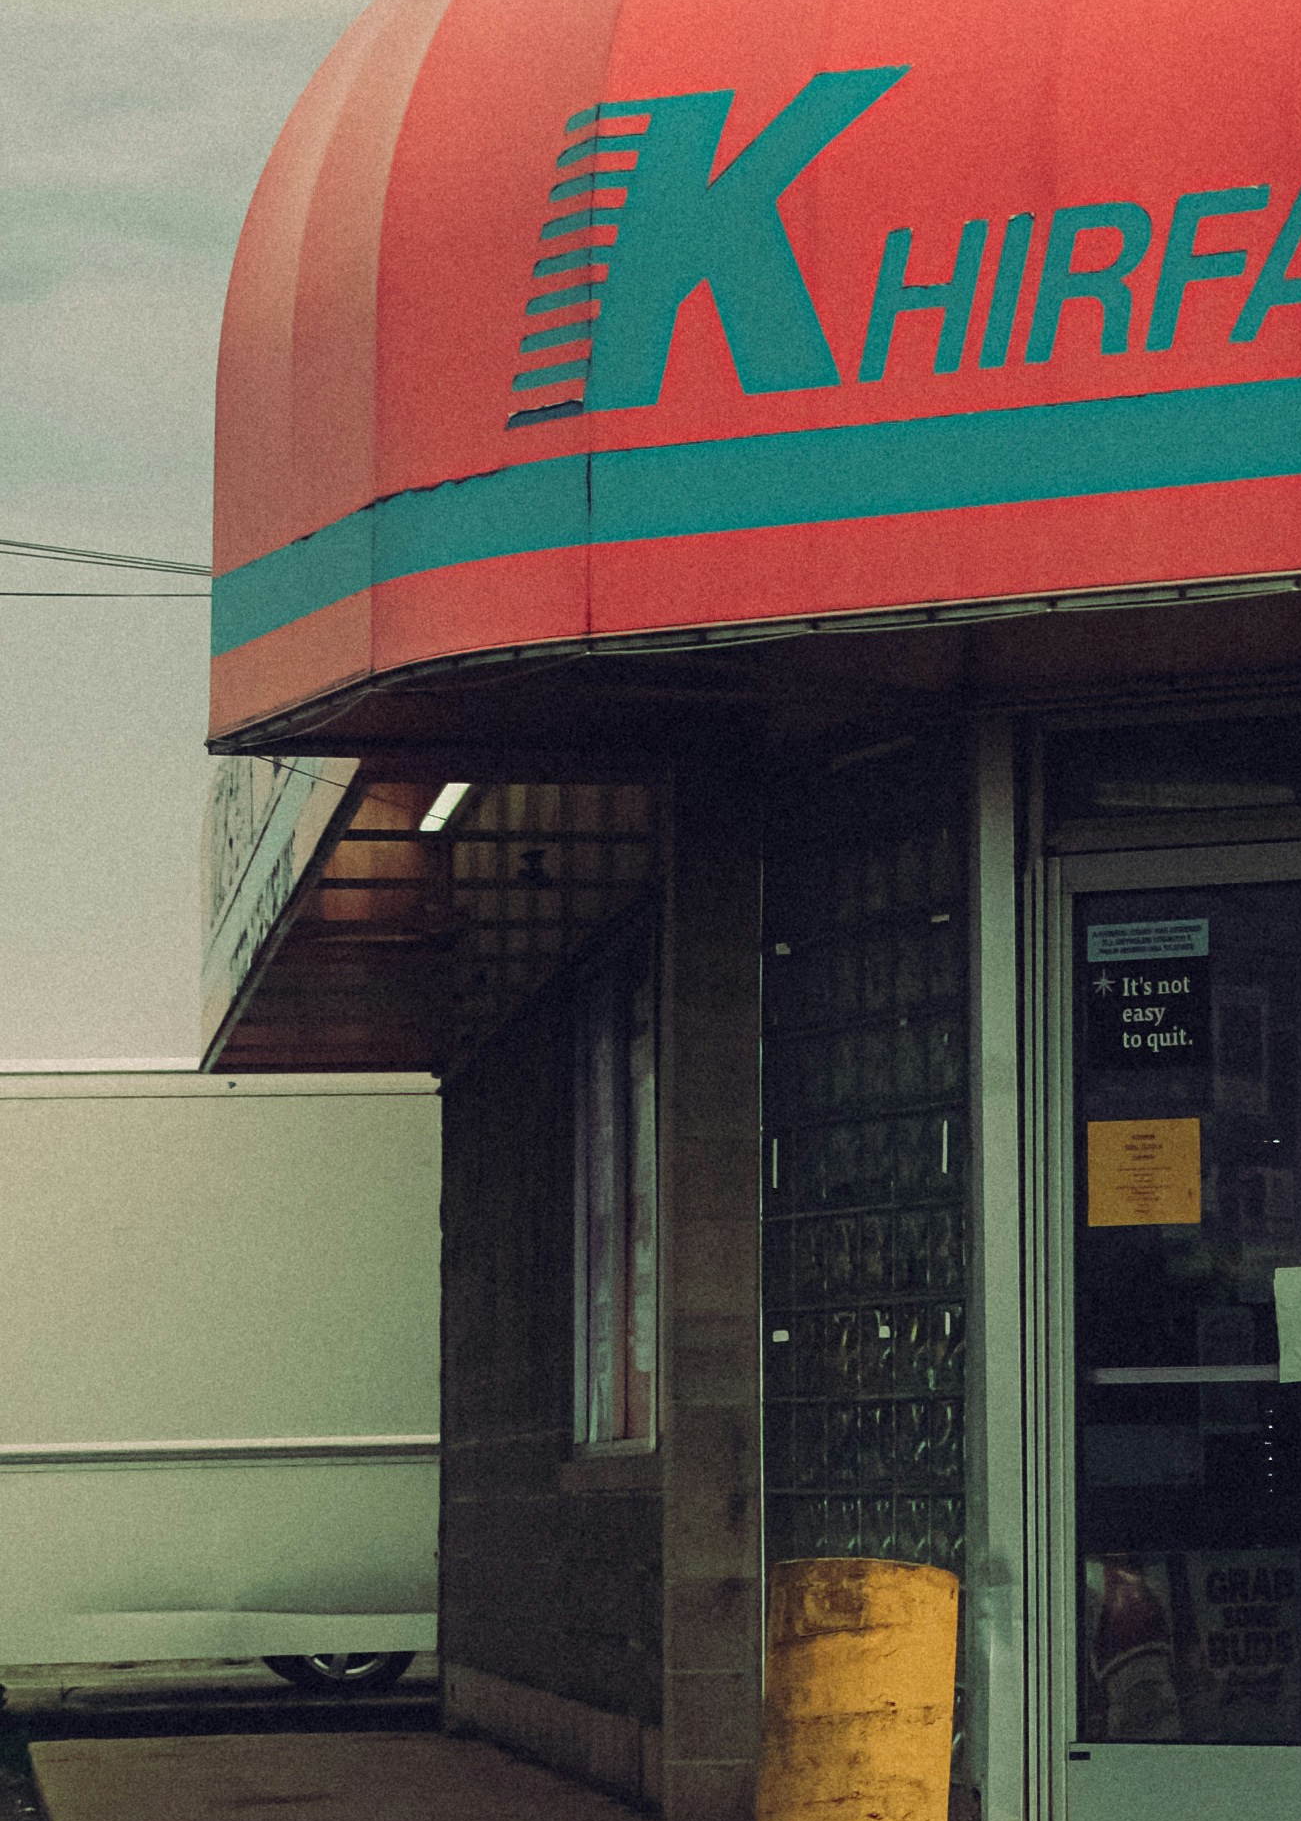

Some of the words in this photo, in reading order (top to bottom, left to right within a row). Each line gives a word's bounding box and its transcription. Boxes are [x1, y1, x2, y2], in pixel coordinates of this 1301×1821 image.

[1122, 975, 1153, 997] It's
[1157, 976, 1191, 995] not
[1121, 1006, 1166, 1027] easy
[1122, 1031, 1142, 1049] to
[1146, 1025, 1194, 1053] quit.
[1205, 1566, 1295, 1604] GRAB
